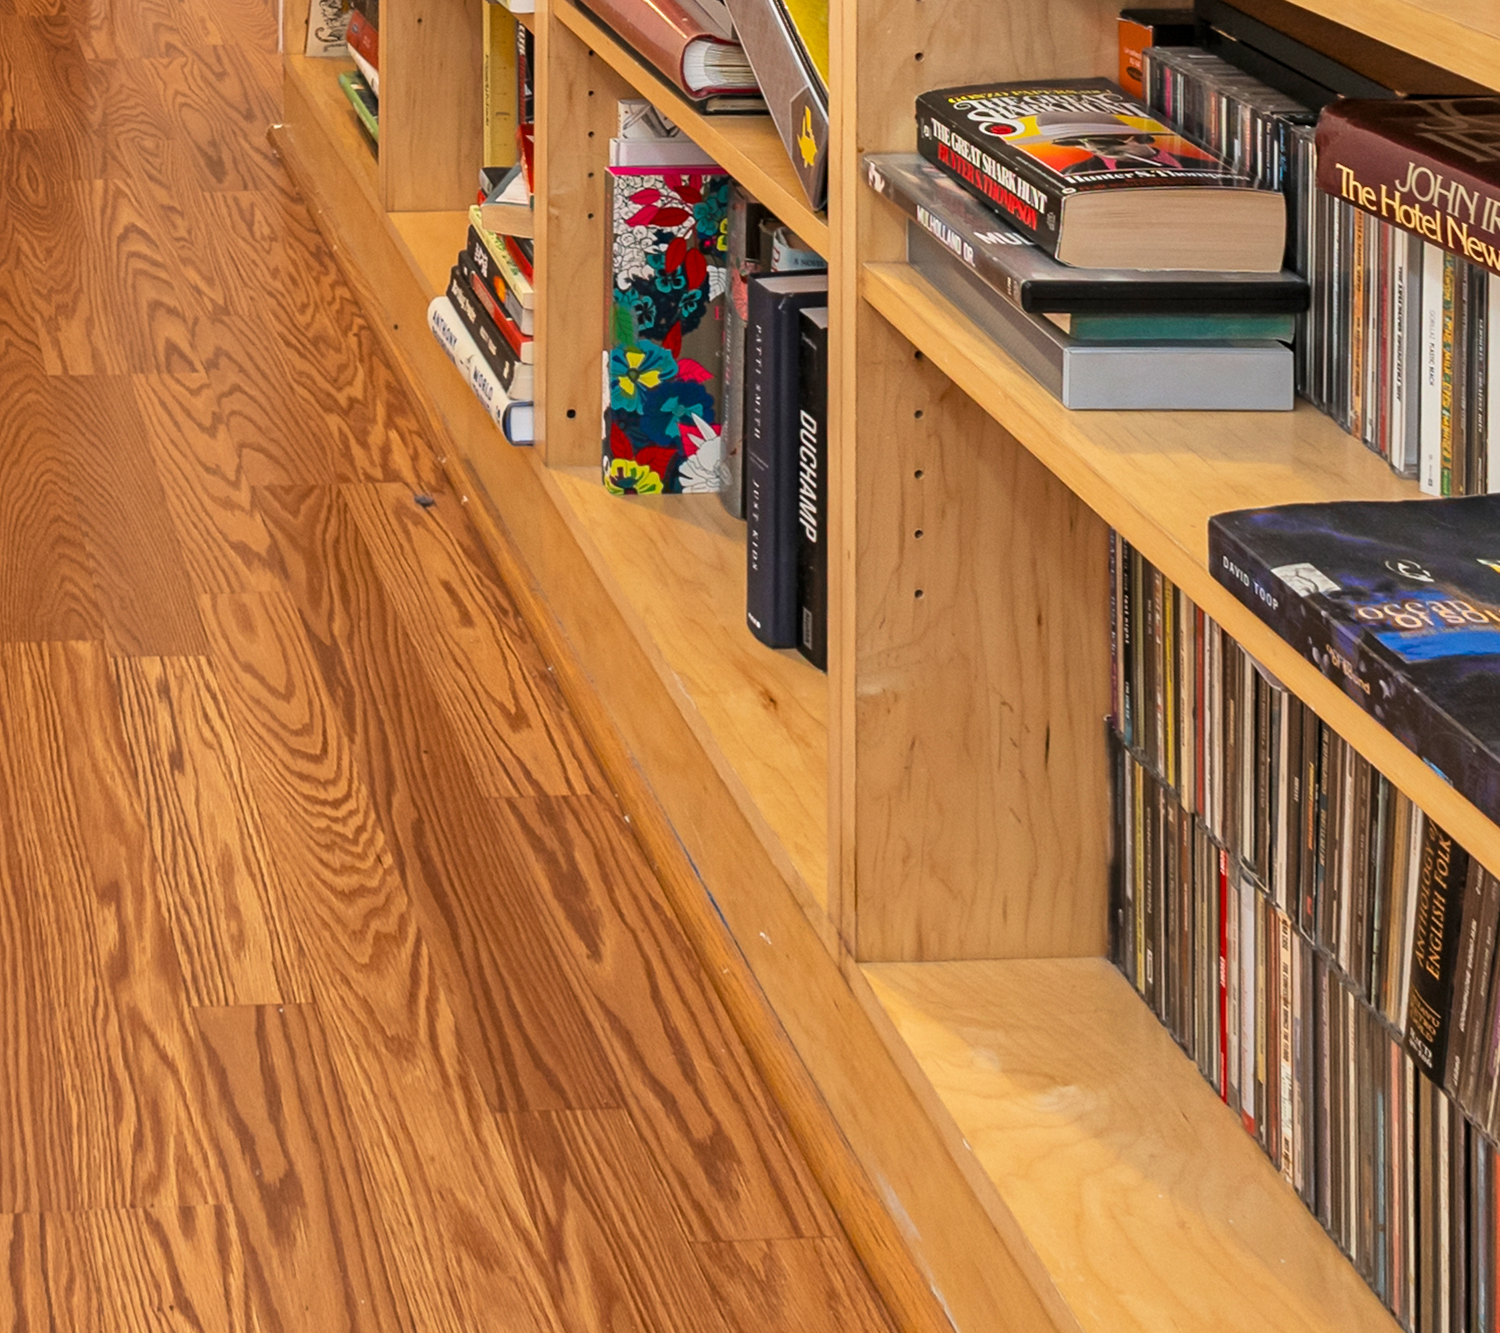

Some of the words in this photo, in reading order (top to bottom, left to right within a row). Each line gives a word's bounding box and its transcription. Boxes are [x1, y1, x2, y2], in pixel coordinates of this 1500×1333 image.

[953, 95, 1016, 111] THE
[1022, 93, 1123, 108] GREAT
[1070, 101, 1151, 118] HUNT
[930, 117, 951, 143] THE
[951, 129, 983, 164] GREAT
[982, 147, 1017, 190] SHARK
[1015, 178, 1048, 214] HUNT
[937, 143, 976, 187] HUNTER
[982, 171, 1038, 231] THOMPSON
[1064, 171, 1134, 183] Hunter
[1395, 161, 1480, 226] JOHN
[1335, 163, 1377, 211] The
[1381, 184, 1443, 242] Hotel
[916, 204, 962, 255] MULHOLLAND
[963, 242, 976, 268] DR.
[432, 309, 459, 347] ANTHONY
[753, 323, 763, 383] PATTI
[1428, 342, 1436, 365] PLASTIC
[473, 366, 494, 401] WORLD
[752, 384, 763, 441] SMITH
[751, 479, 761, 521] JUST
[799, 409, 819, 543] DUCHAMP
[750, 529, 760, 573] KIDS
[1221, 554, 1250, 590] DAVID
[1253, 578, 1280, 611] TOOP
[1434, 832, 1452, 889] FOLK
[1414, 846, 1434, 968] ANTHOLOGY
[1427, 817, 1439, 842] of
[1426, 890, 1447, 980] ENGLISH
[1459, 970, 1472, 1033] BROTHERHOOD
